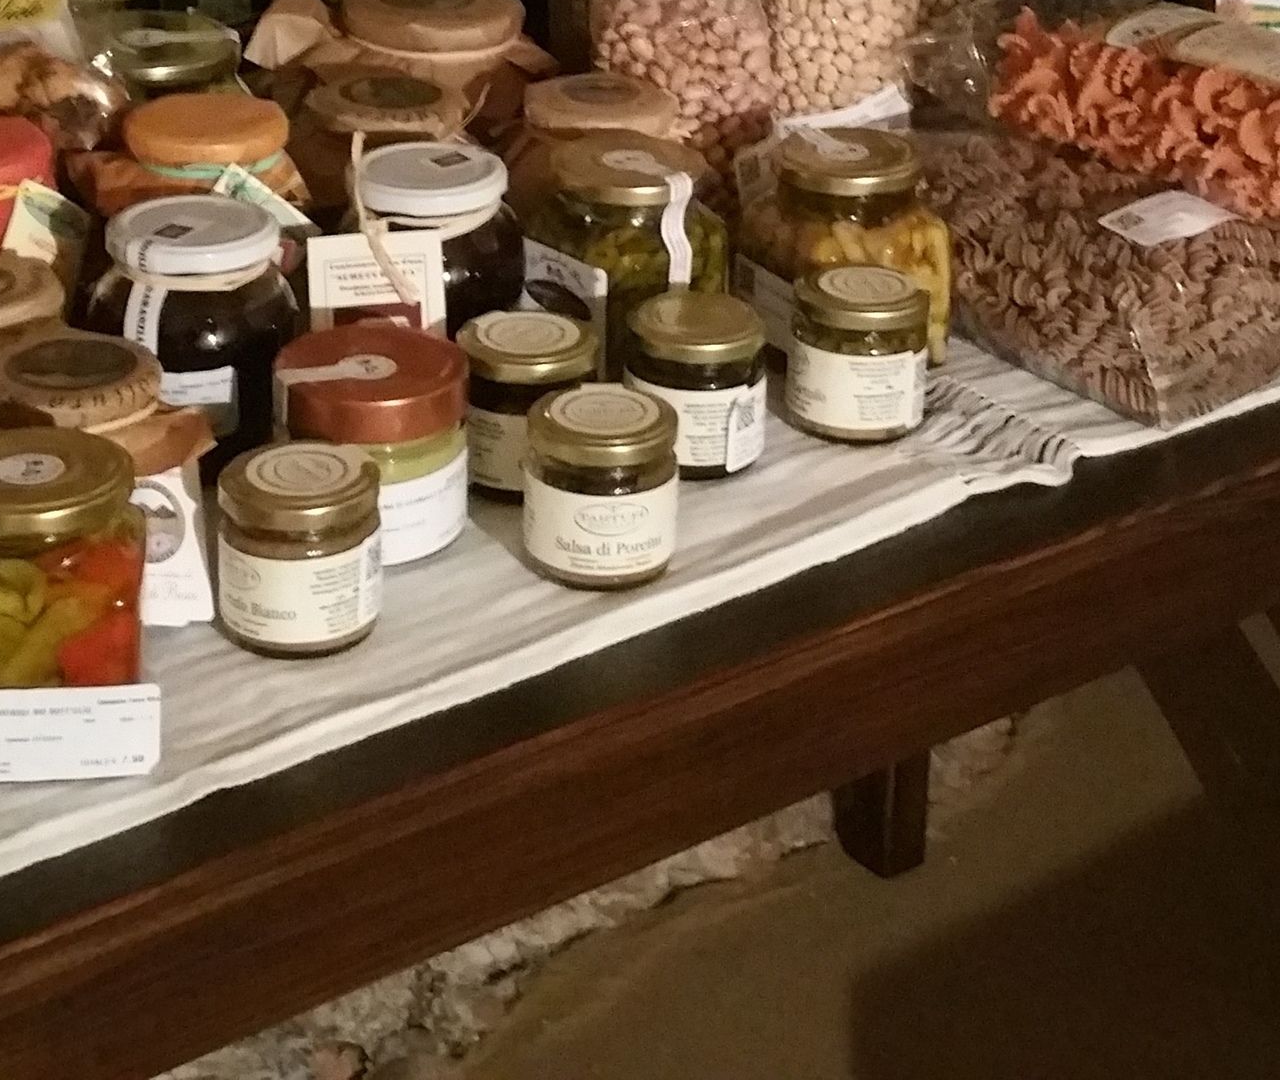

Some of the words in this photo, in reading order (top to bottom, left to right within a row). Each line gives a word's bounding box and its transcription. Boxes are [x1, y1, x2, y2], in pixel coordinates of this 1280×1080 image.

[554, 535, 593, 556] Salsa
[595, 541, 611, 556] di
[250, 602, 297, 622] Bianco
